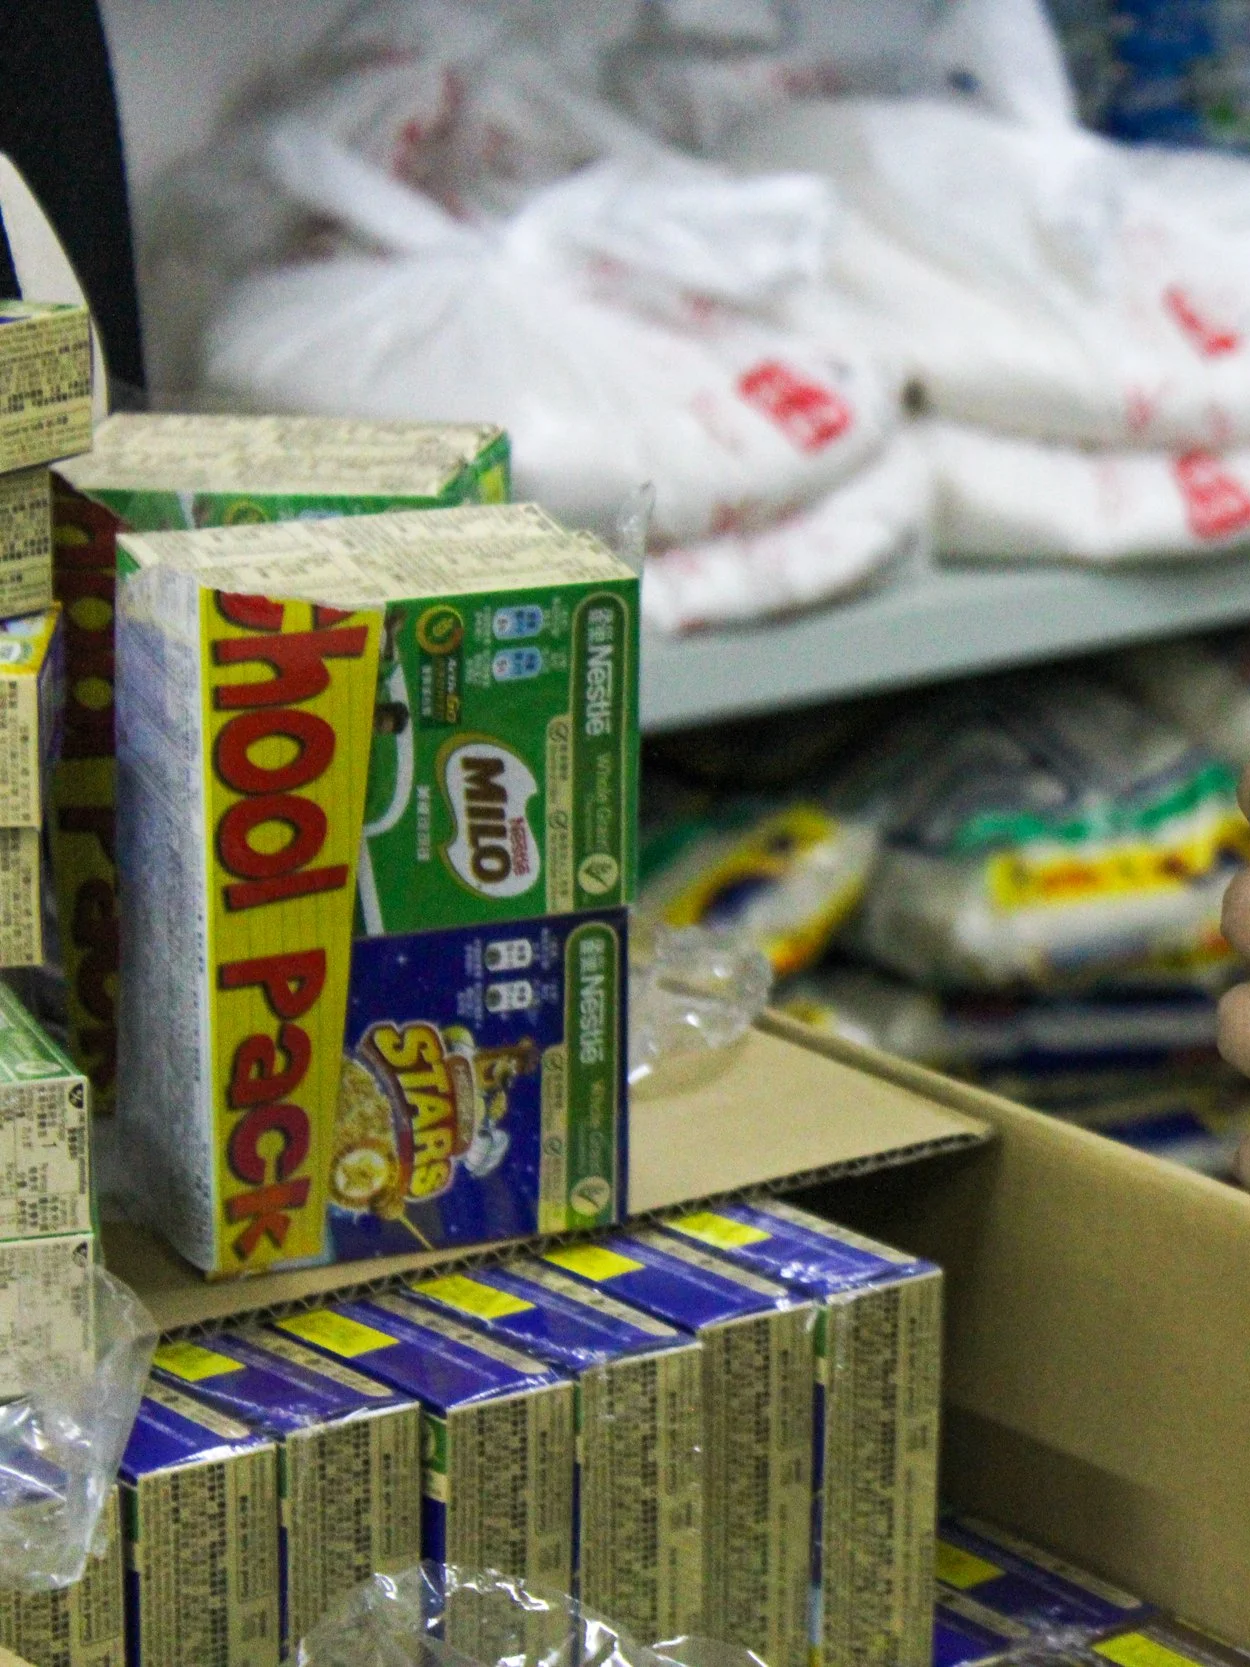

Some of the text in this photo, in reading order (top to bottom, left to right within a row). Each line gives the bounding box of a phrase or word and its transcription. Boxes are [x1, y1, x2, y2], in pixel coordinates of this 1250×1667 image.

[461, 756, 511, 884] MILO
[210, 589, 368, 1263] chool Pack
[372, 1024, 454, 1198] STARS
